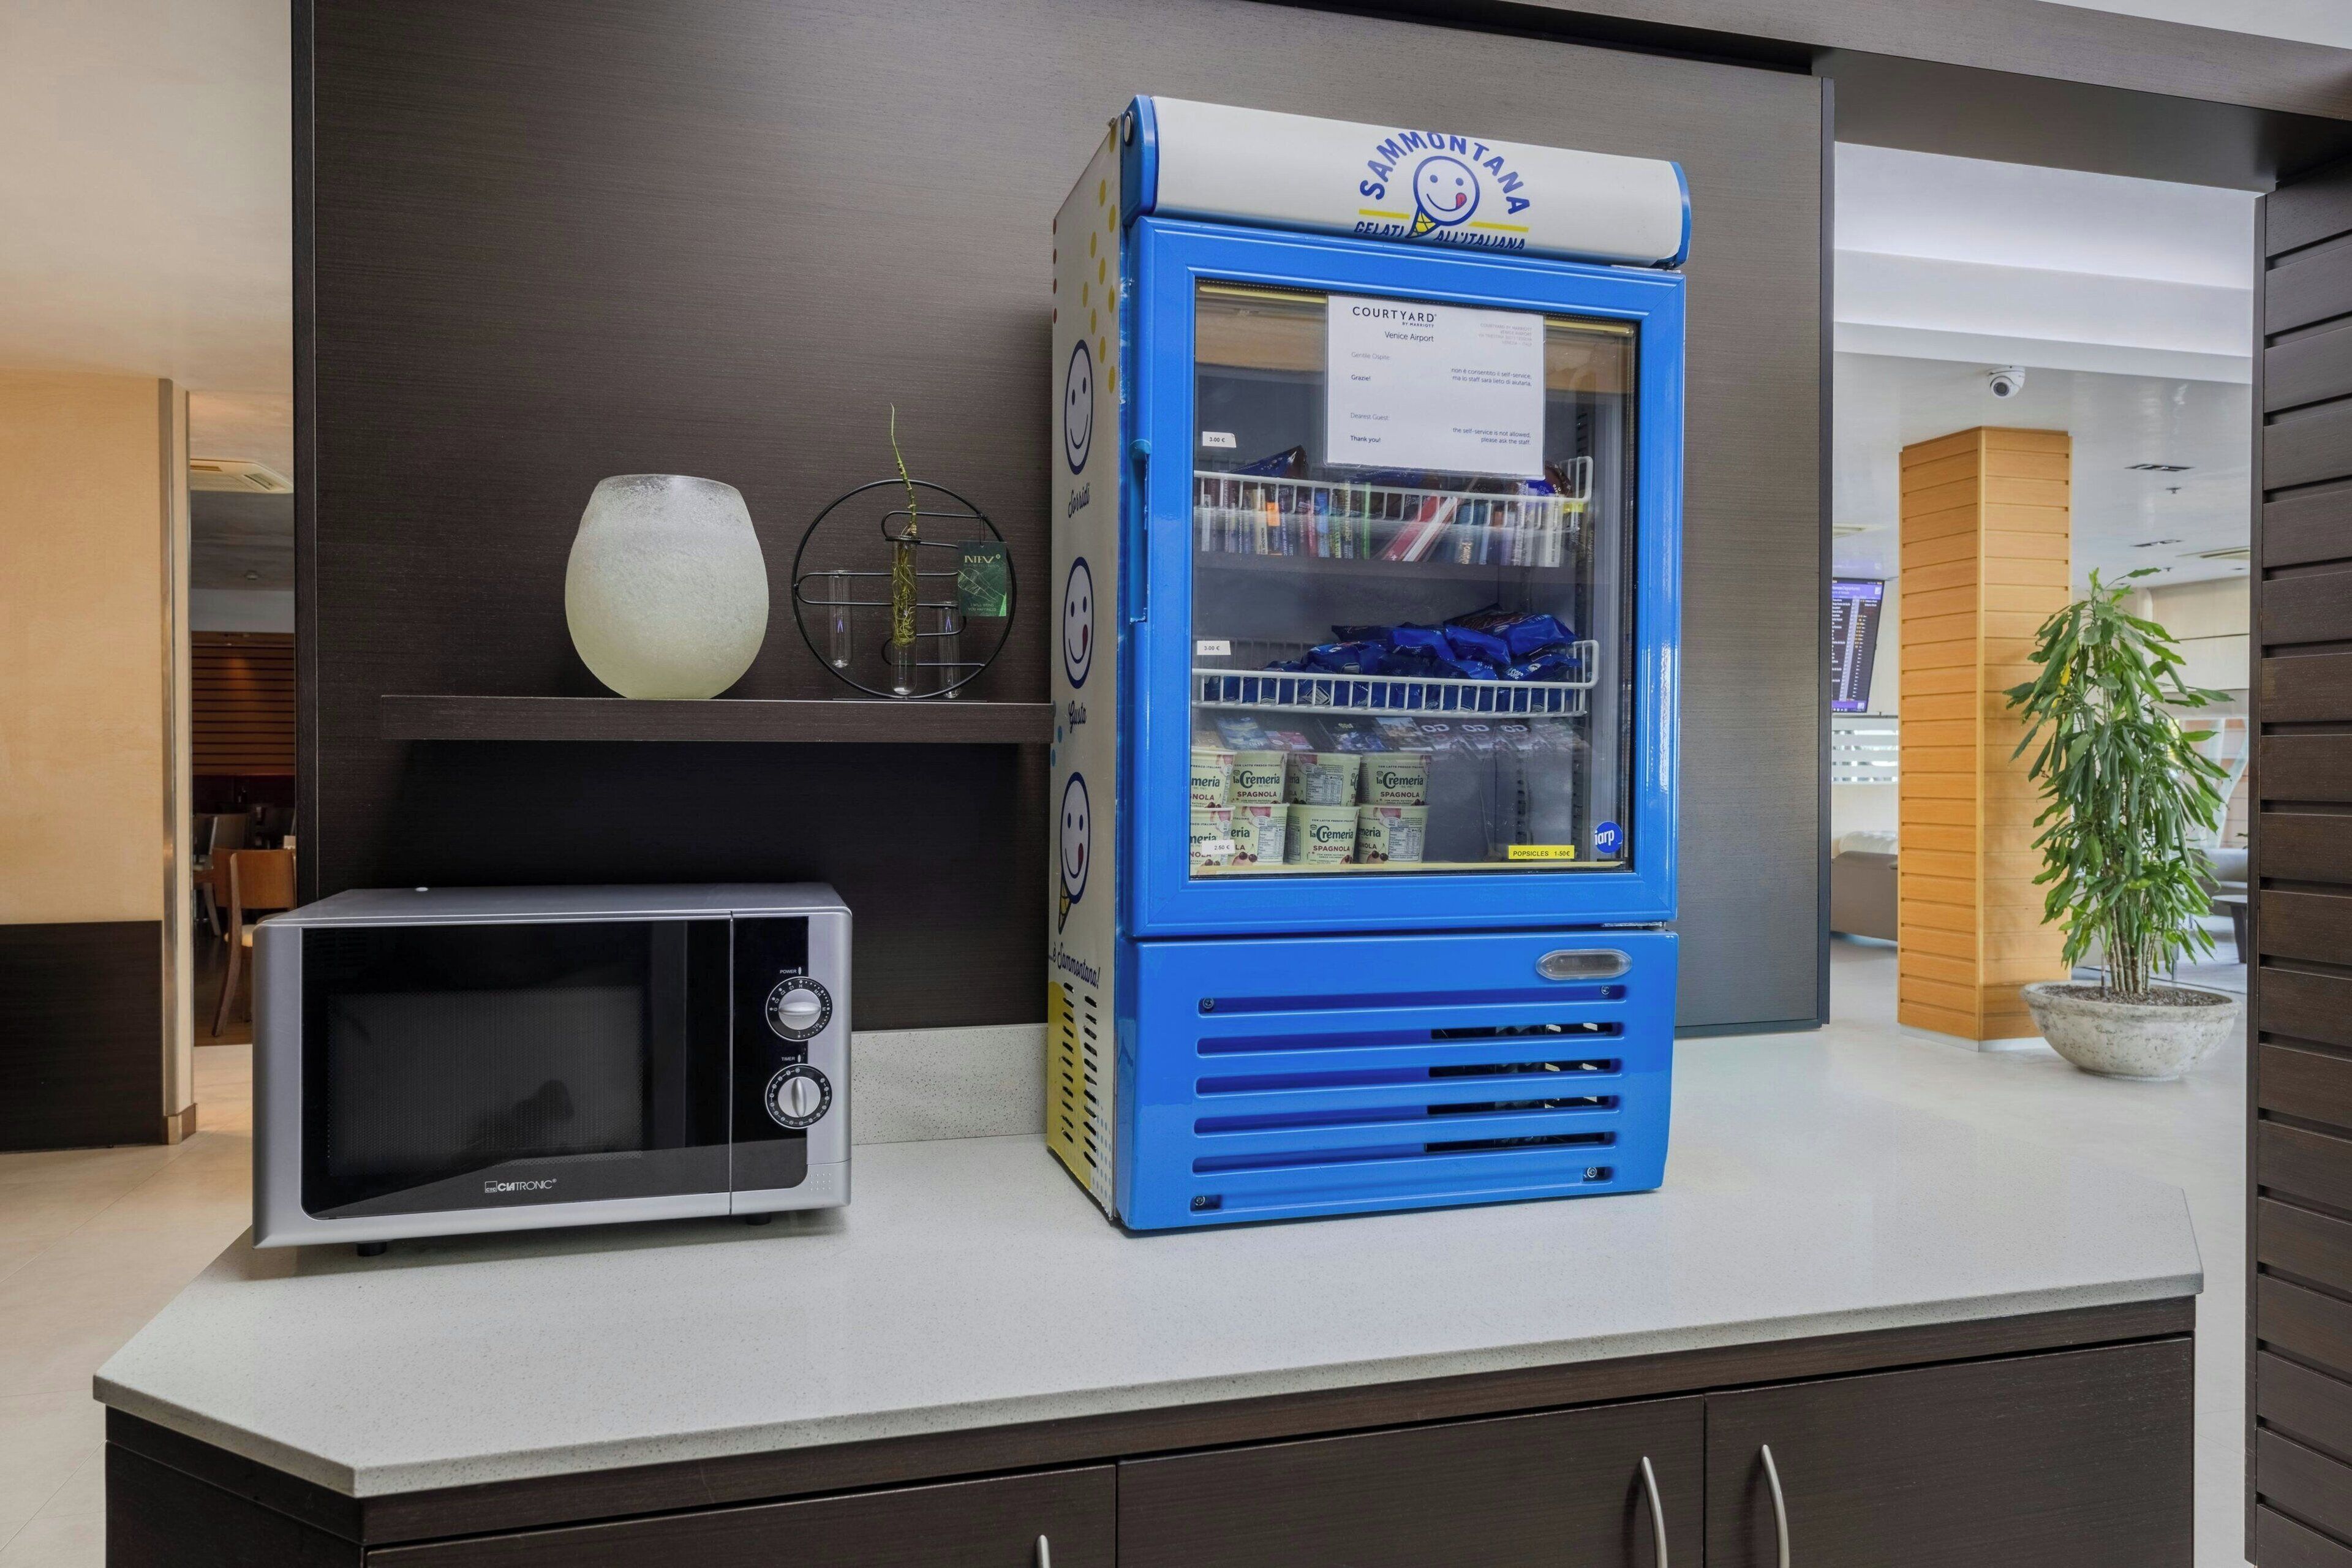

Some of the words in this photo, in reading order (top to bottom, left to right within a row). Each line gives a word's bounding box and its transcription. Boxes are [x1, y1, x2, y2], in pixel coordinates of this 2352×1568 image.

[1359, 131, 1530, 214] SAMMONTANA
[1354, 221, 1404, 237] GELATI
[1433, 230, 1526, 250] ALL'ITALIANA
[1352, 306, 1434, 322] COURTYARD
[1385, 331, 1408, 340] Venice
[1410, 333, 1434, 342] Airport
[1191, 775, 1220, 787] meria
[1240, 770, 1280, 788] Cremeria
[1382, 772, 1424, 789] Cremeria
[1231, 827, 1250, 837] eria
[1316, 825, 1354, 843] Cremeria
[1594, 830, 1615, 846] iarp
